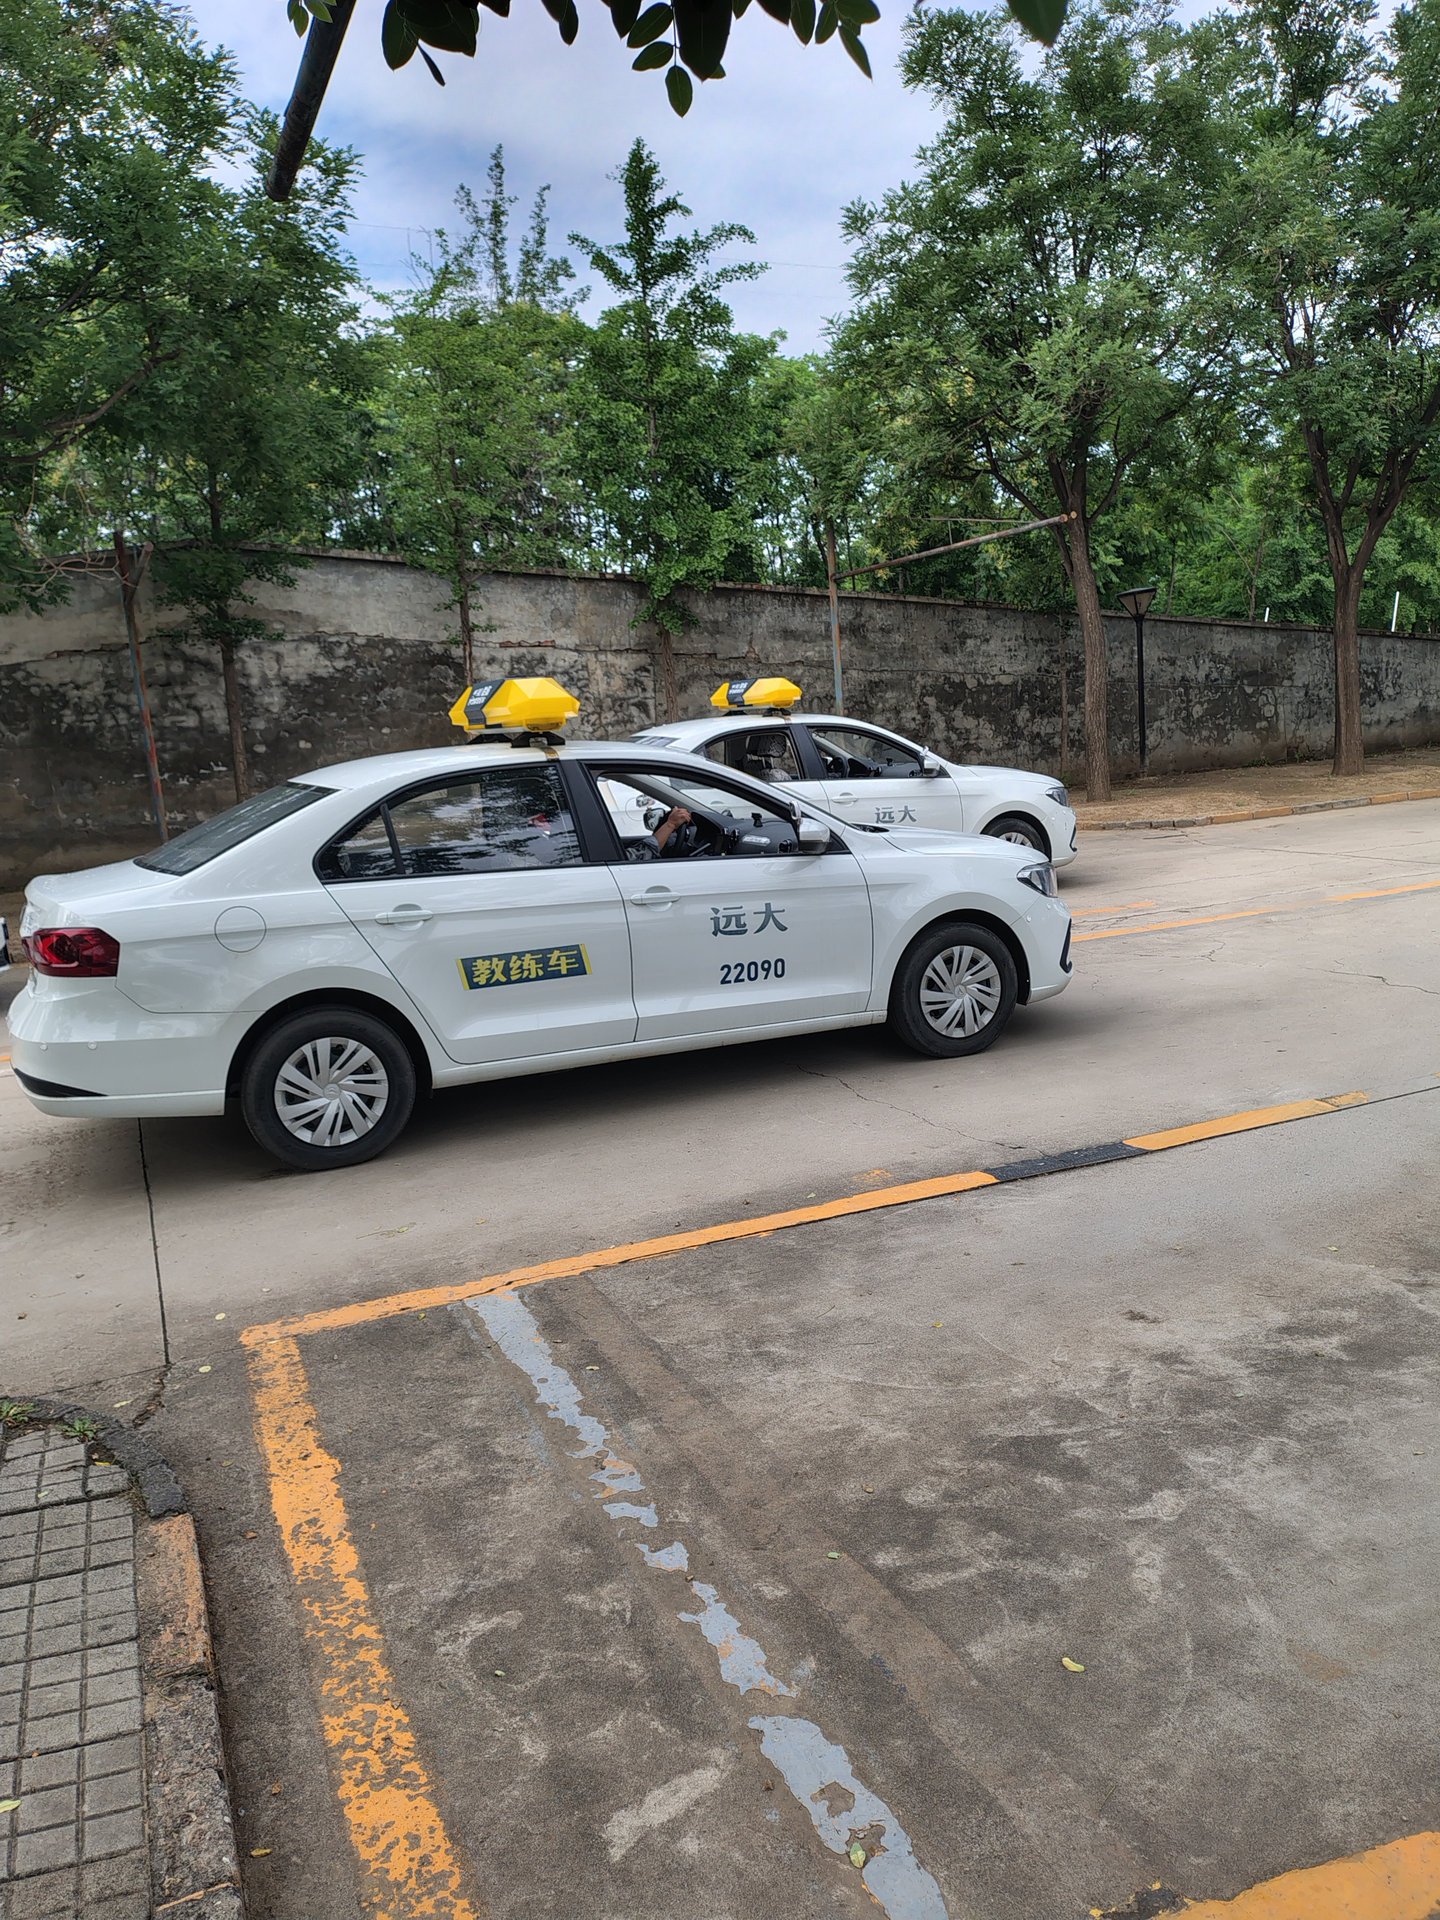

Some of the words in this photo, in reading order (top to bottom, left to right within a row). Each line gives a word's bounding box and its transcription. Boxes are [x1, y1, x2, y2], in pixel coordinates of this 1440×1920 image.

[875, 805, 917, 824] 远大
[710, 902, 788, 937] 远大
[472, 949, 579, 985] 教练车
[720, 958, 785, 985] 22090
